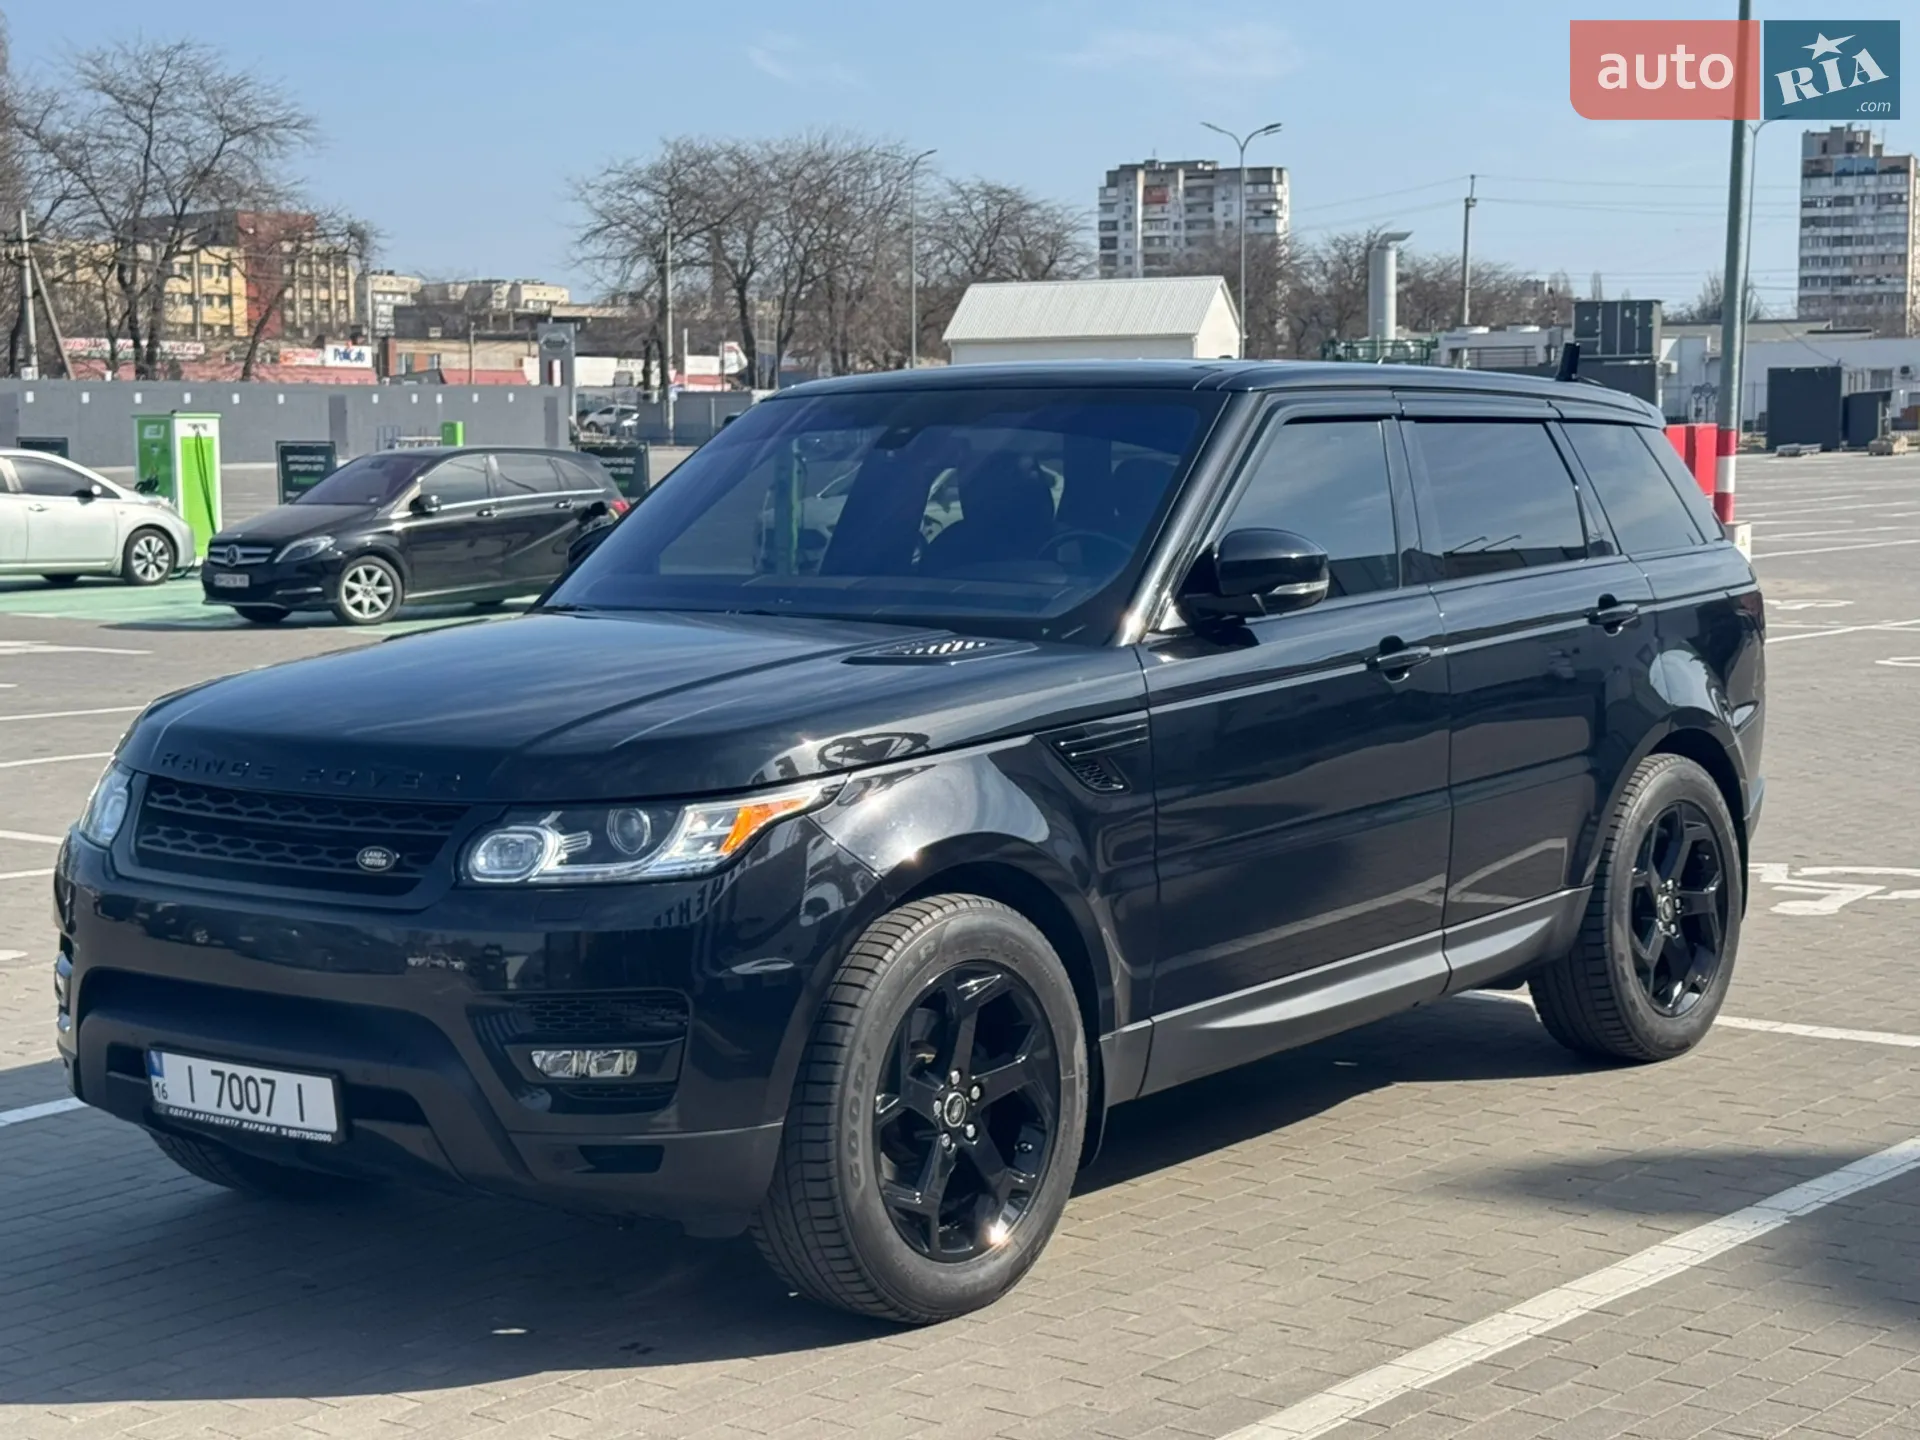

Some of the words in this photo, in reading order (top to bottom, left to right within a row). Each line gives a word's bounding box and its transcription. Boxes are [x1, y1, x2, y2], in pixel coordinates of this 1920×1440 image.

[160, 751, 276, 781] RANGE
[154, 1082, 168, 1100] 16
[210, 1068, 276, 1118] 7007
[194, 1113, 240, 1129] АВТОЦЕНТР
